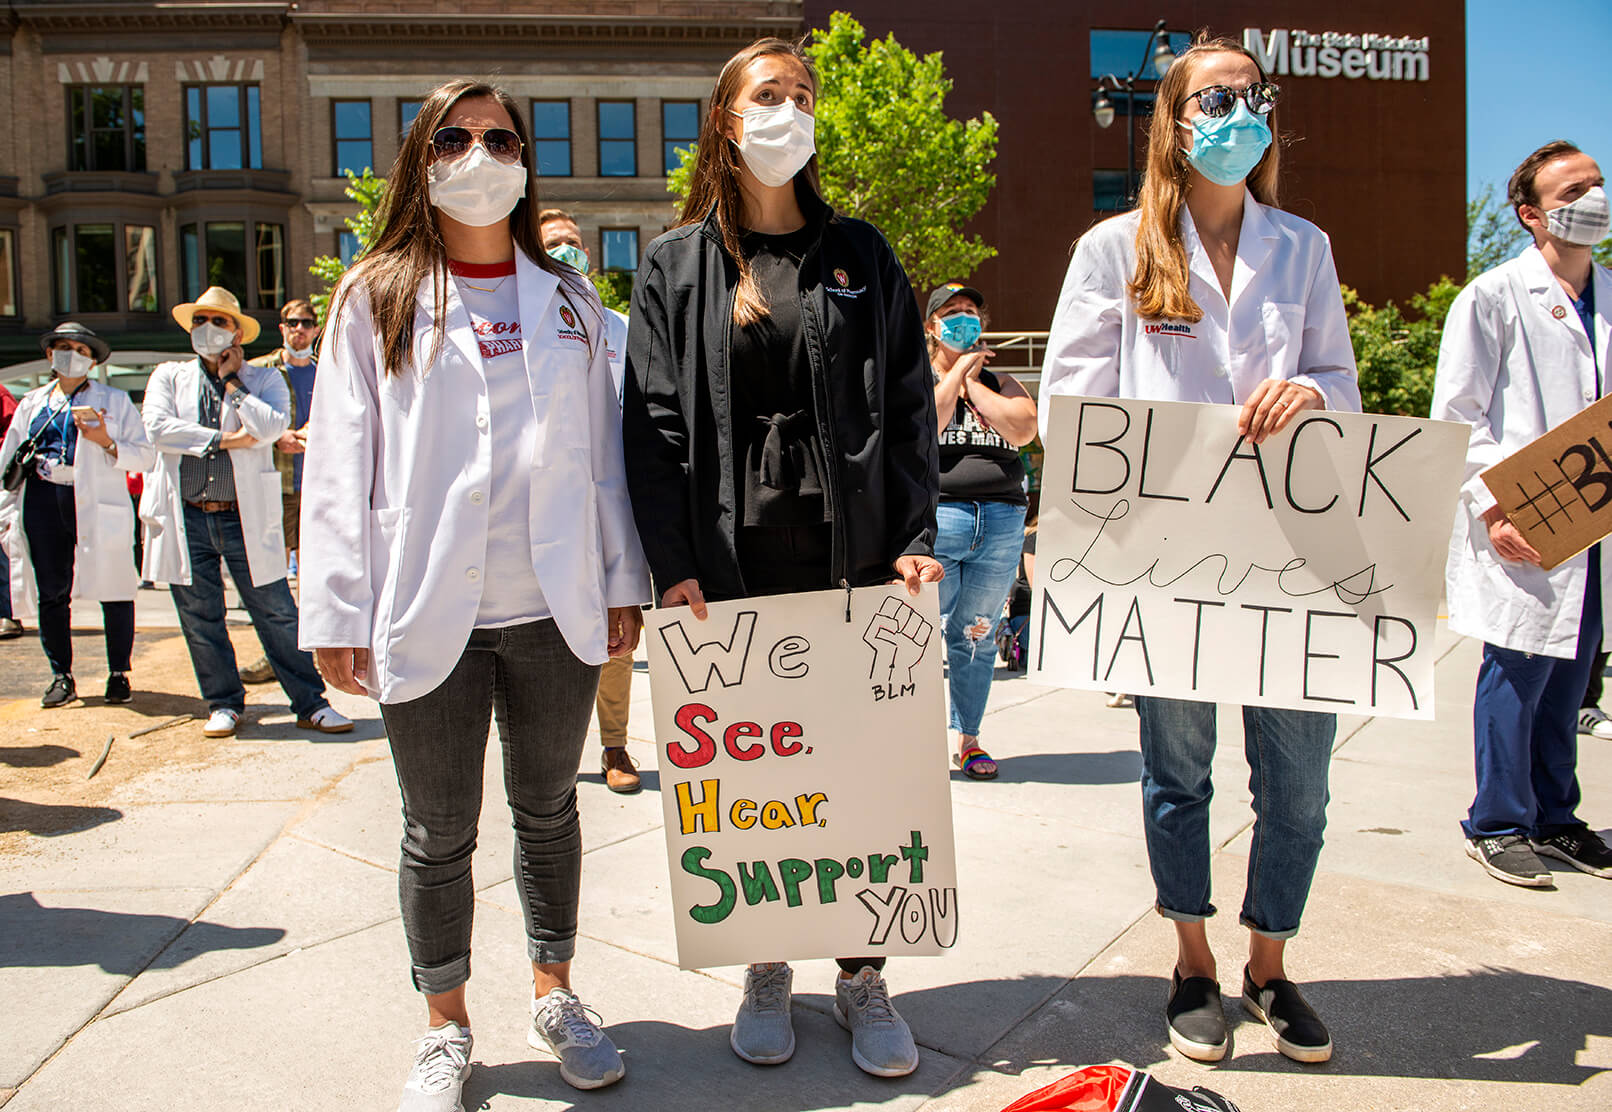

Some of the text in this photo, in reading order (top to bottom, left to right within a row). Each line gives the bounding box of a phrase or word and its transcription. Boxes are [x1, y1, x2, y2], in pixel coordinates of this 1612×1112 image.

[1244, 28, 1430, 81] Museum
[1071, 402, 1422, 522] BLACK
[1050, 498, 1394, 605] Lives
[659, 610, 811, 694] We
[871, 682, 916, 702] BLM
[1037, 587, 1419, 711] MATTER
[680, 830, 929, 925] Support
[855, 886, 959, 949] YOU
